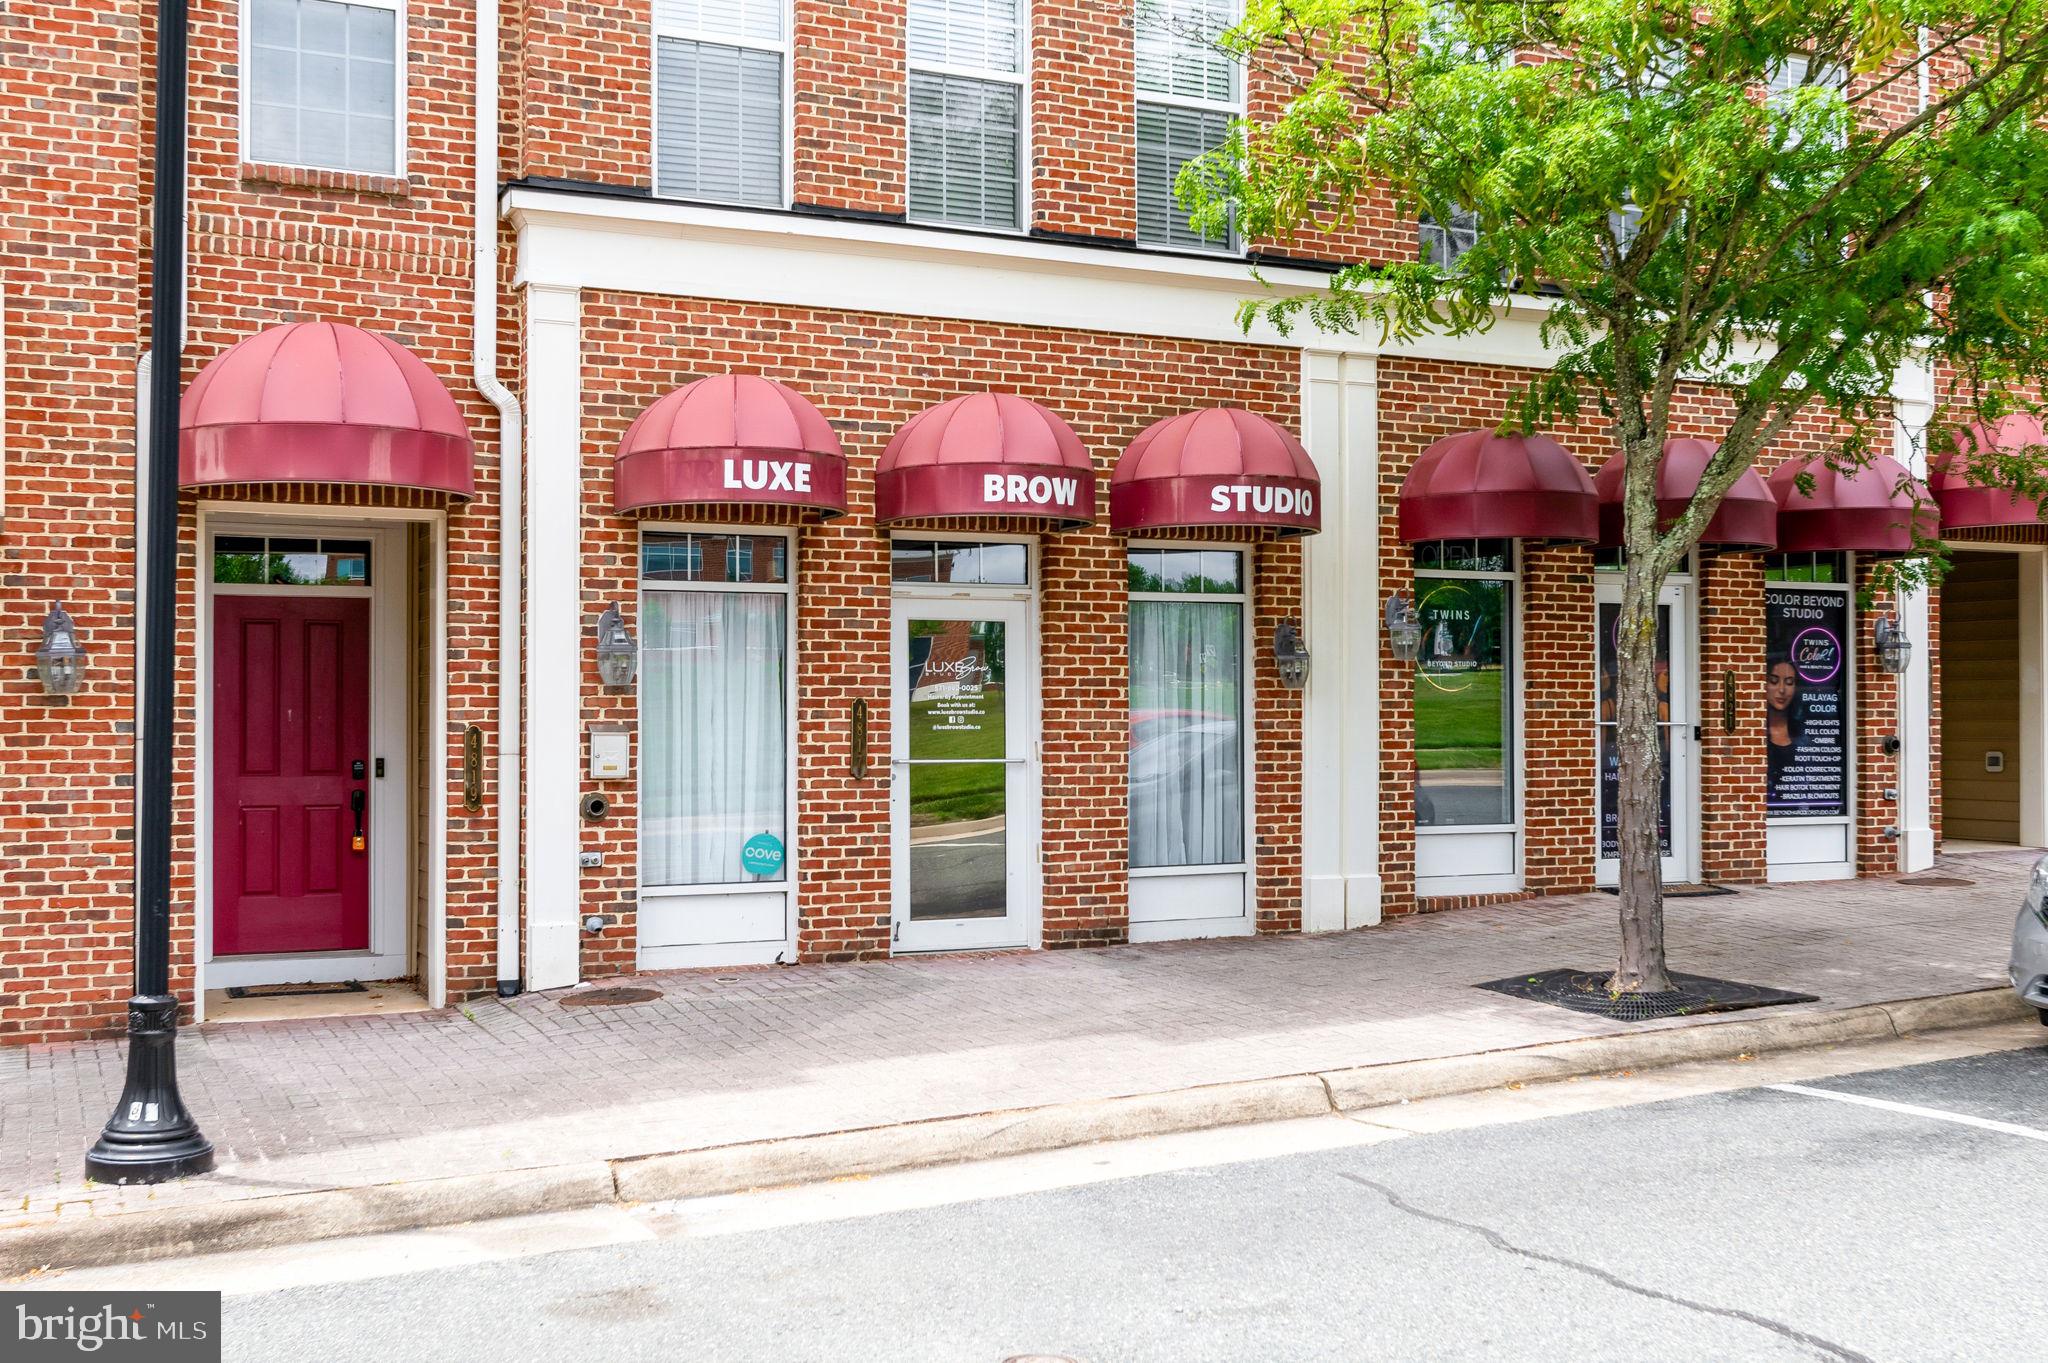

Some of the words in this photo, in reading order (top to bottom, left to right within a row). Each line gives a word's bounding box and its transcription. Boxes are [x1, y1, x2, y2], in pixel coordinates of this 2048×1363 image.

[723, 459, 811, 493] LUXE
[983, 473, 1078, 507] BROW
[1210, 485, 1313, 517] STUDIO
[1765, 593, 1801, 605] COLOR
[1802, 595, 1845, 608] BEYOND
[1432, 609, 1471, 620] TWINS
[1782, 607, 1824, 619] STUDIO
[1803, 638, 1830, 646] TWINS
[925, 660, 966, 673] LUXE
[1427, 660, 1453, 668] BEYOND
[1454, 660, 1478, 668] STUDIO
[1809, 704, 1837, 713] COLOR
[470, 733, 478, 801] 4819
